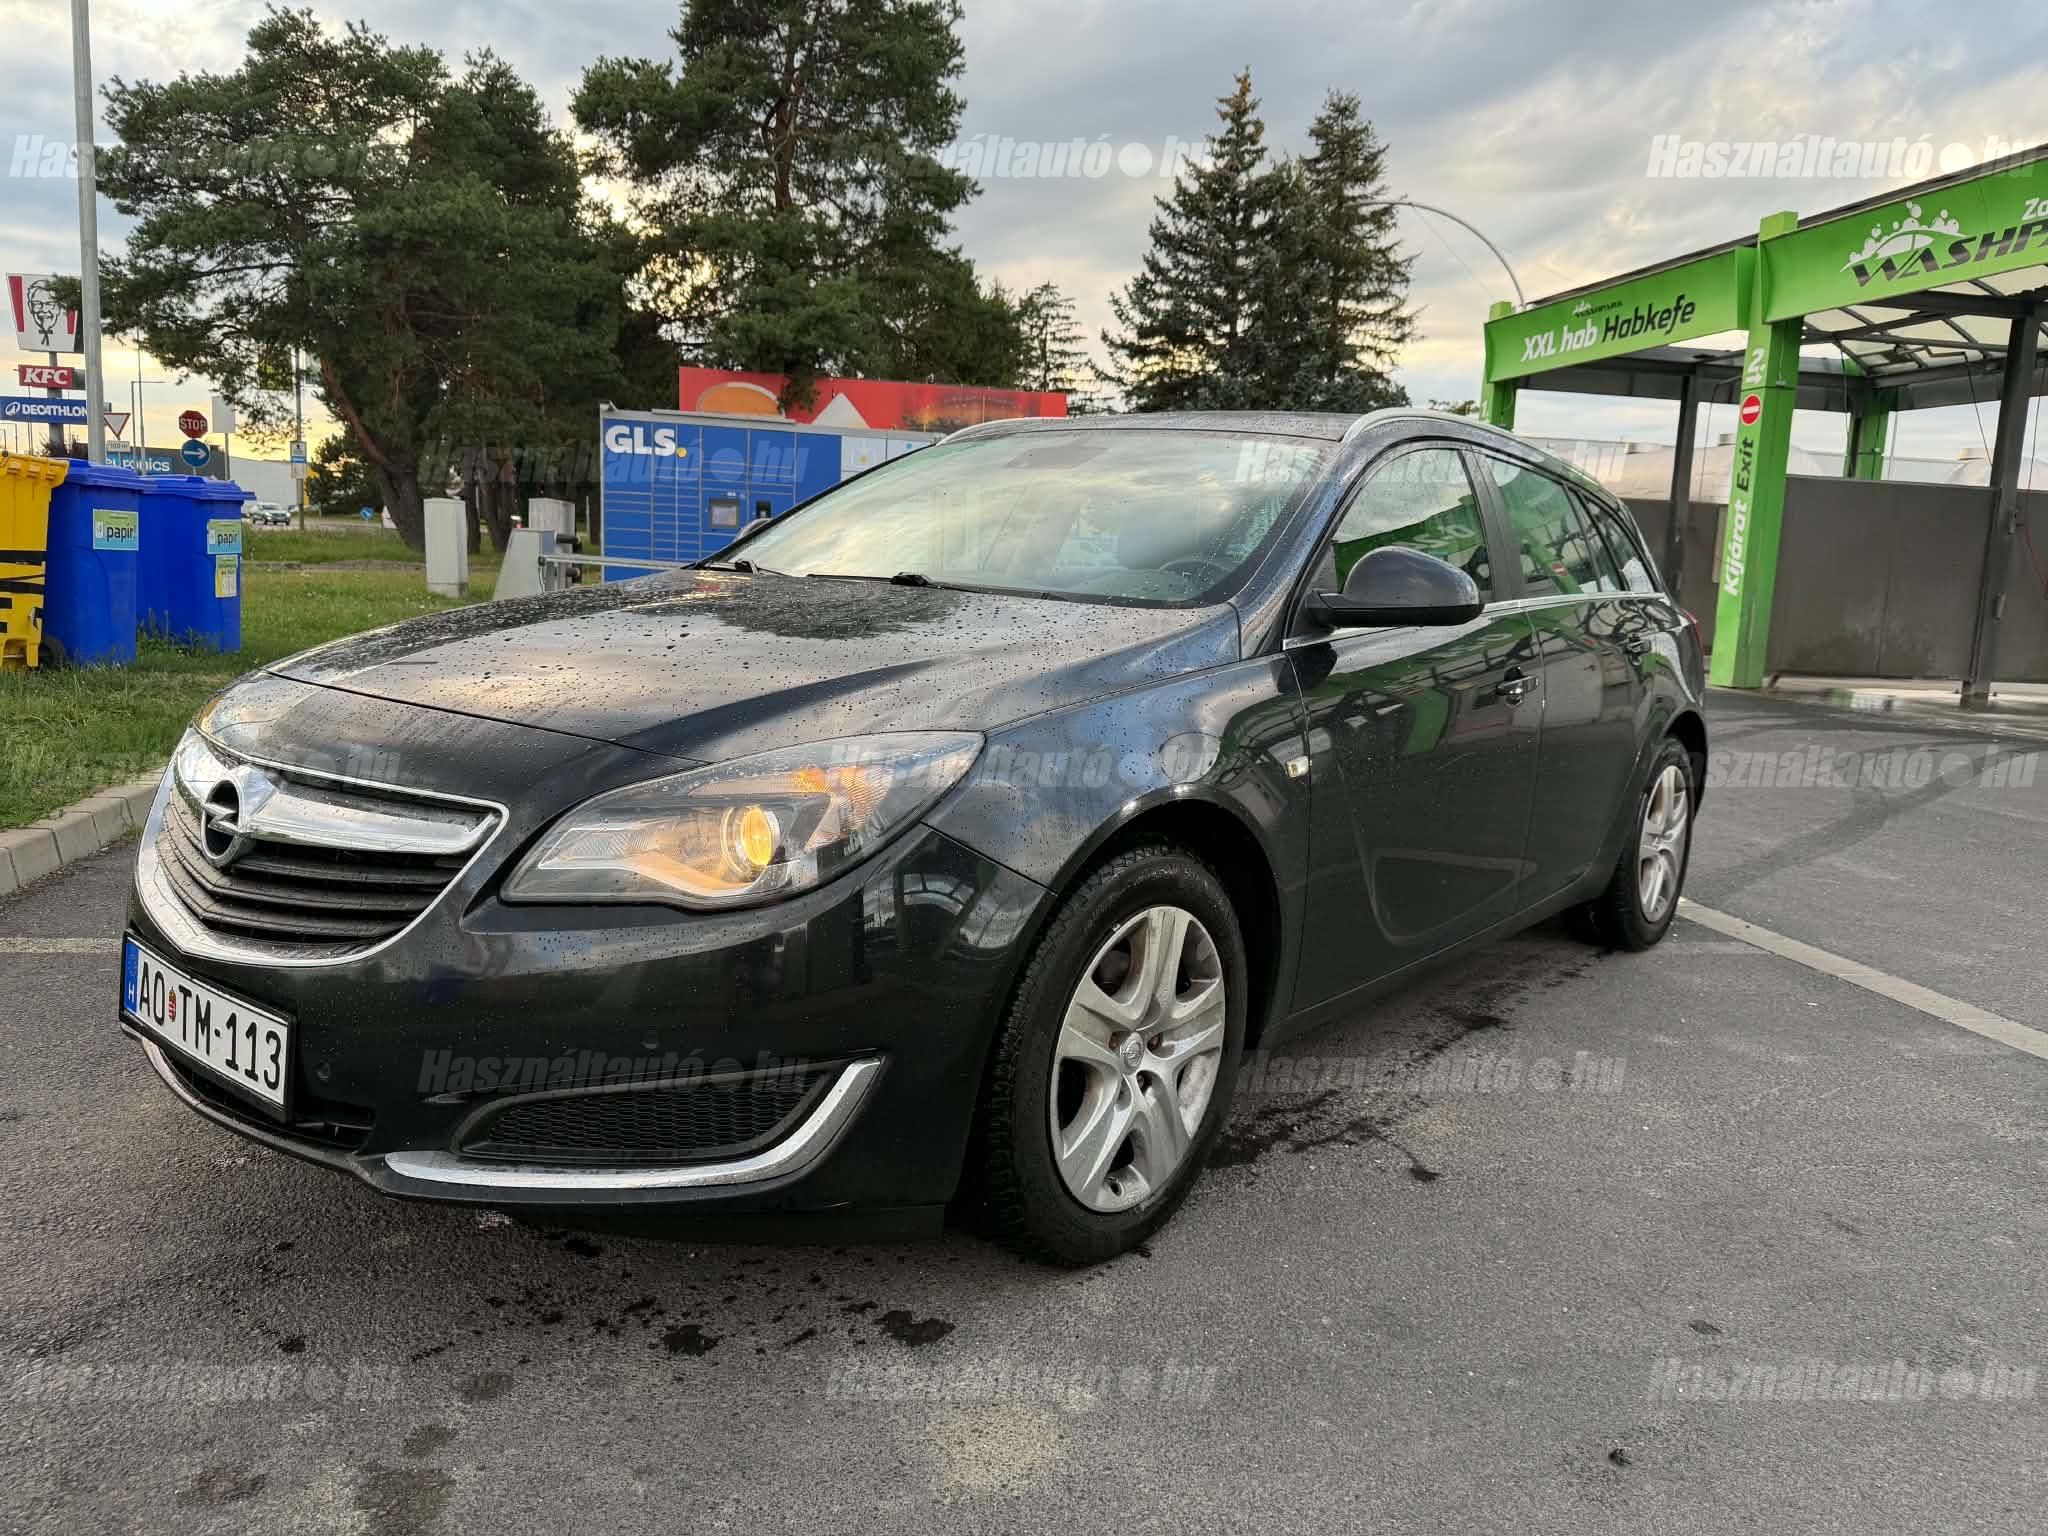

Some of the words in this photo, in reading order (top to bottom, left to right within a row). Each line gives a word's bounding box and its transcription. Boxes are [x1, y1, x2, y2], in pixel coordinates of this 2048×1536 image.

[1852, 219, 2048, 288] WASHP
[1521, 336, 1556, 362] XXL
[1560, 319, 1598, 352] hab
[1602, 294, 1696, 343] Habkefe
[24, 367, 68, 385] KFC
[22, 404, 88, 417] DECATHLON
[180, 418, 207, 431] STOP
[1724, 500, 1748, 596] Kijárat
[1736, 437, 1753, 493] Exit
[178, 984, 283, 1091] TM-113
